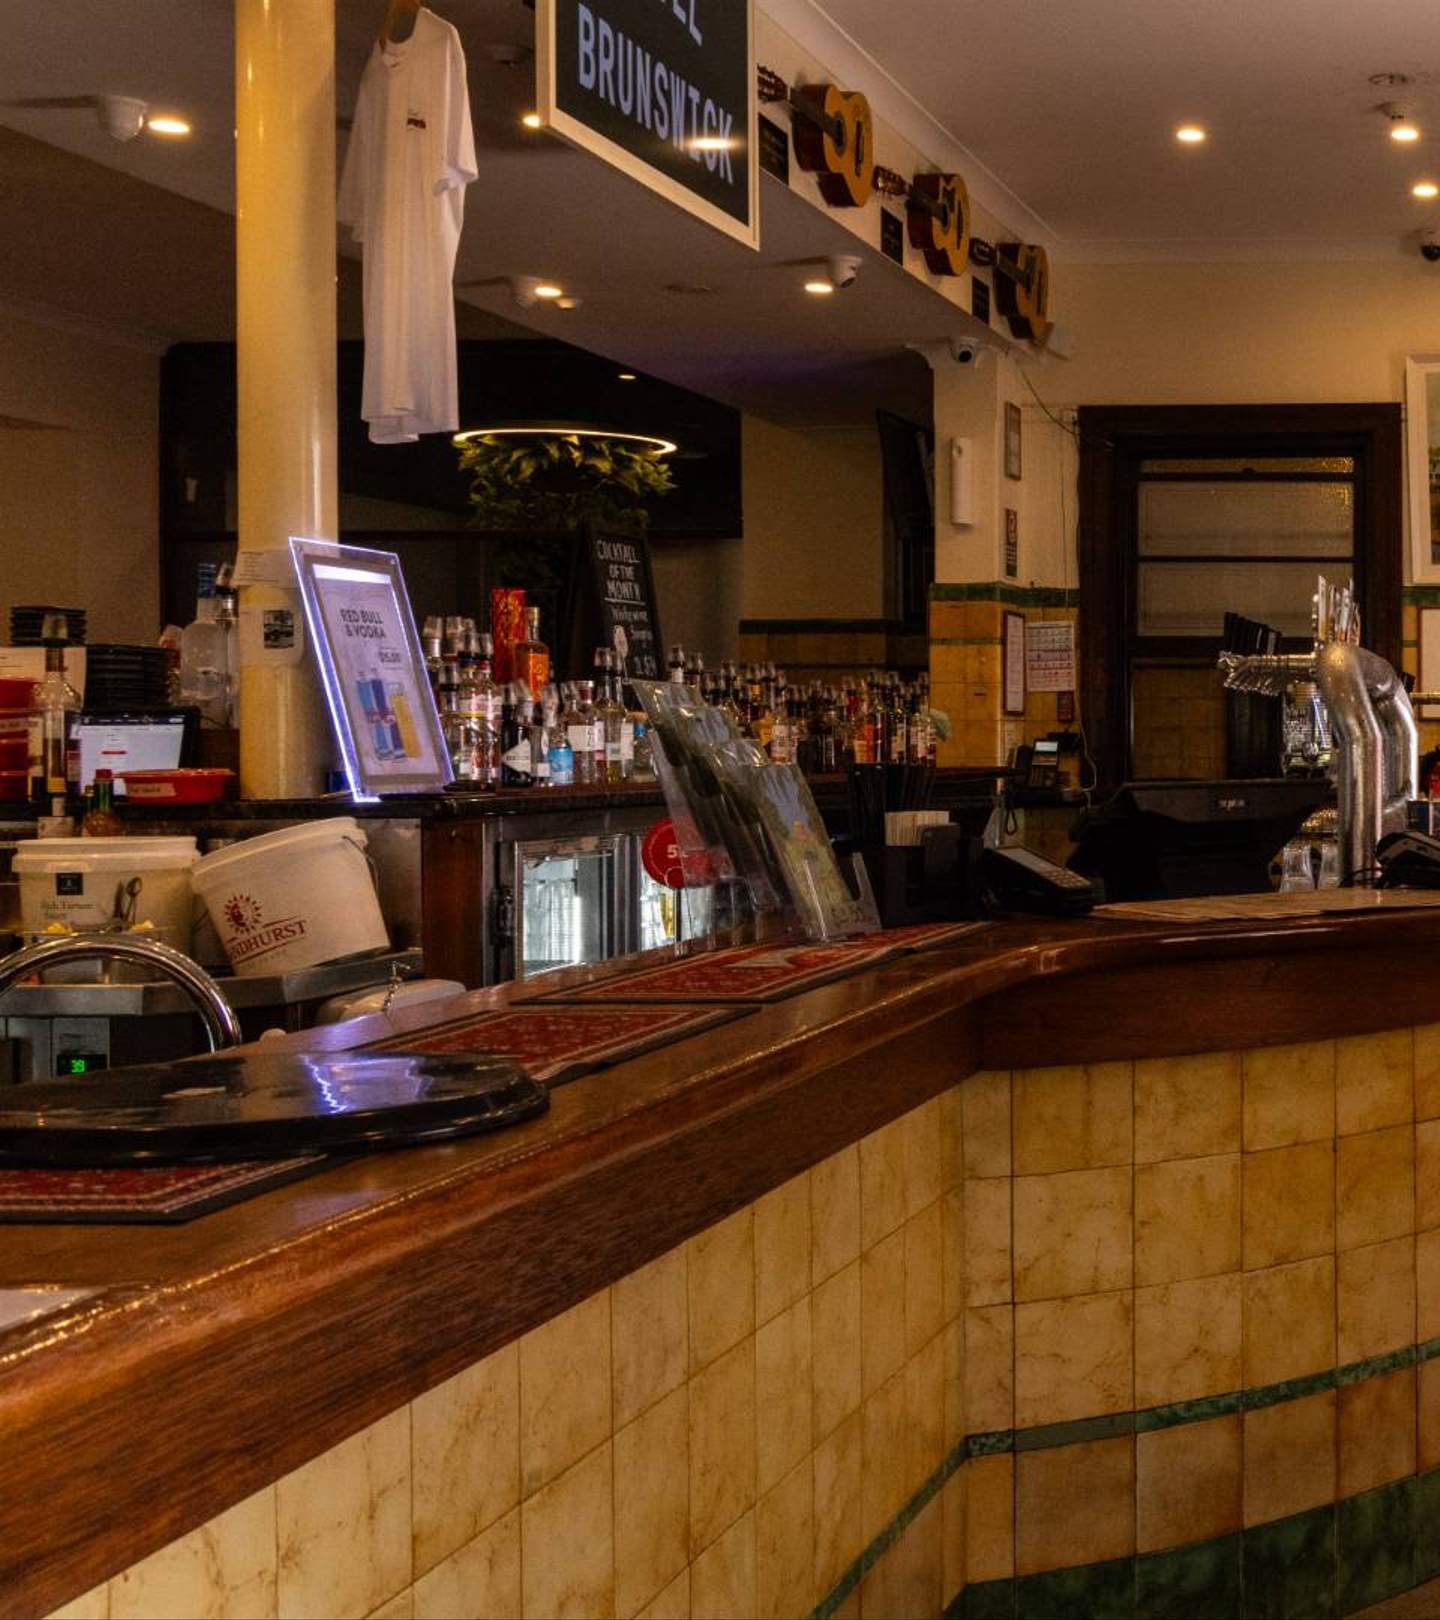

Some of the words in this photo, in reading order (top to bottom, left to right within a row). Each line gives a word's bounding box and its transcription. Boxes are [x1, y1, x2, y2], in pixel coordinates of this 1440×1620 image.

[578, 3, 733, 185] BRUNSWICK
[340, 608, 360, 622] RED
[360, 610, 384, 624] BULL
[354, 625, 387, 638] VODKA
[231, 919, 307, 960] NDHURST
